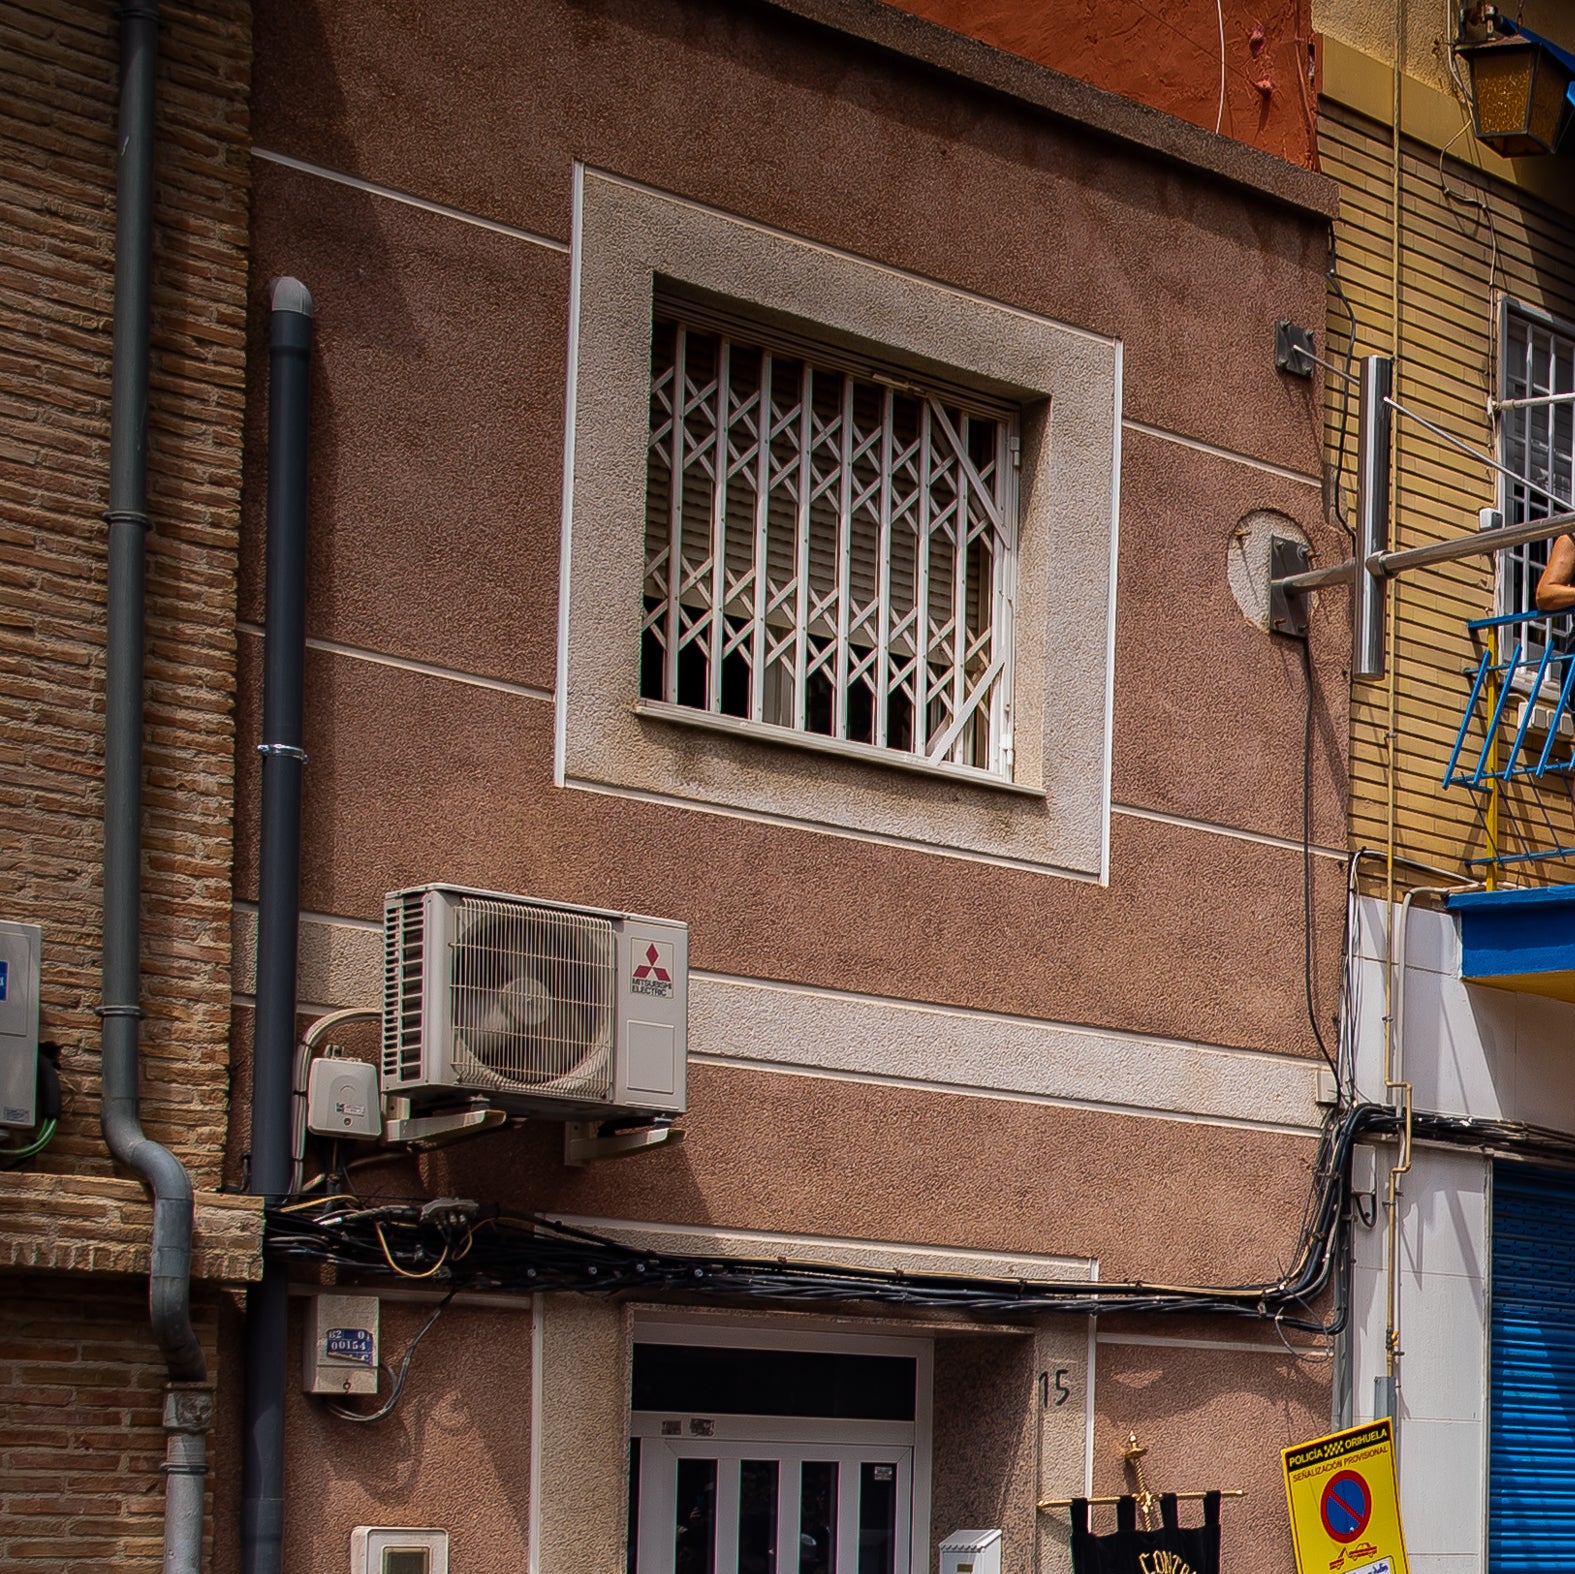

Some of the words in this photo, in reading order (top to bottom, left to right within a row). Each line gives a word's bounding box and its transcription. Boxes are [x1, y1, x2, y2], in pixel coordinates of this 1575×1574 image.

[331, 1340, 366, 1350] 00154
[1039, 1369, 1070, 1408] 15
[1290, 1447, 1323, 1467] POLICÍA
[1344, 1428, 1388, 1449] ORIHUELA
[1292, 1460, 1342, 1482] SEÑALIZACIÓN
[1344, 1445, 1388, 1467] PROVISIONAL
